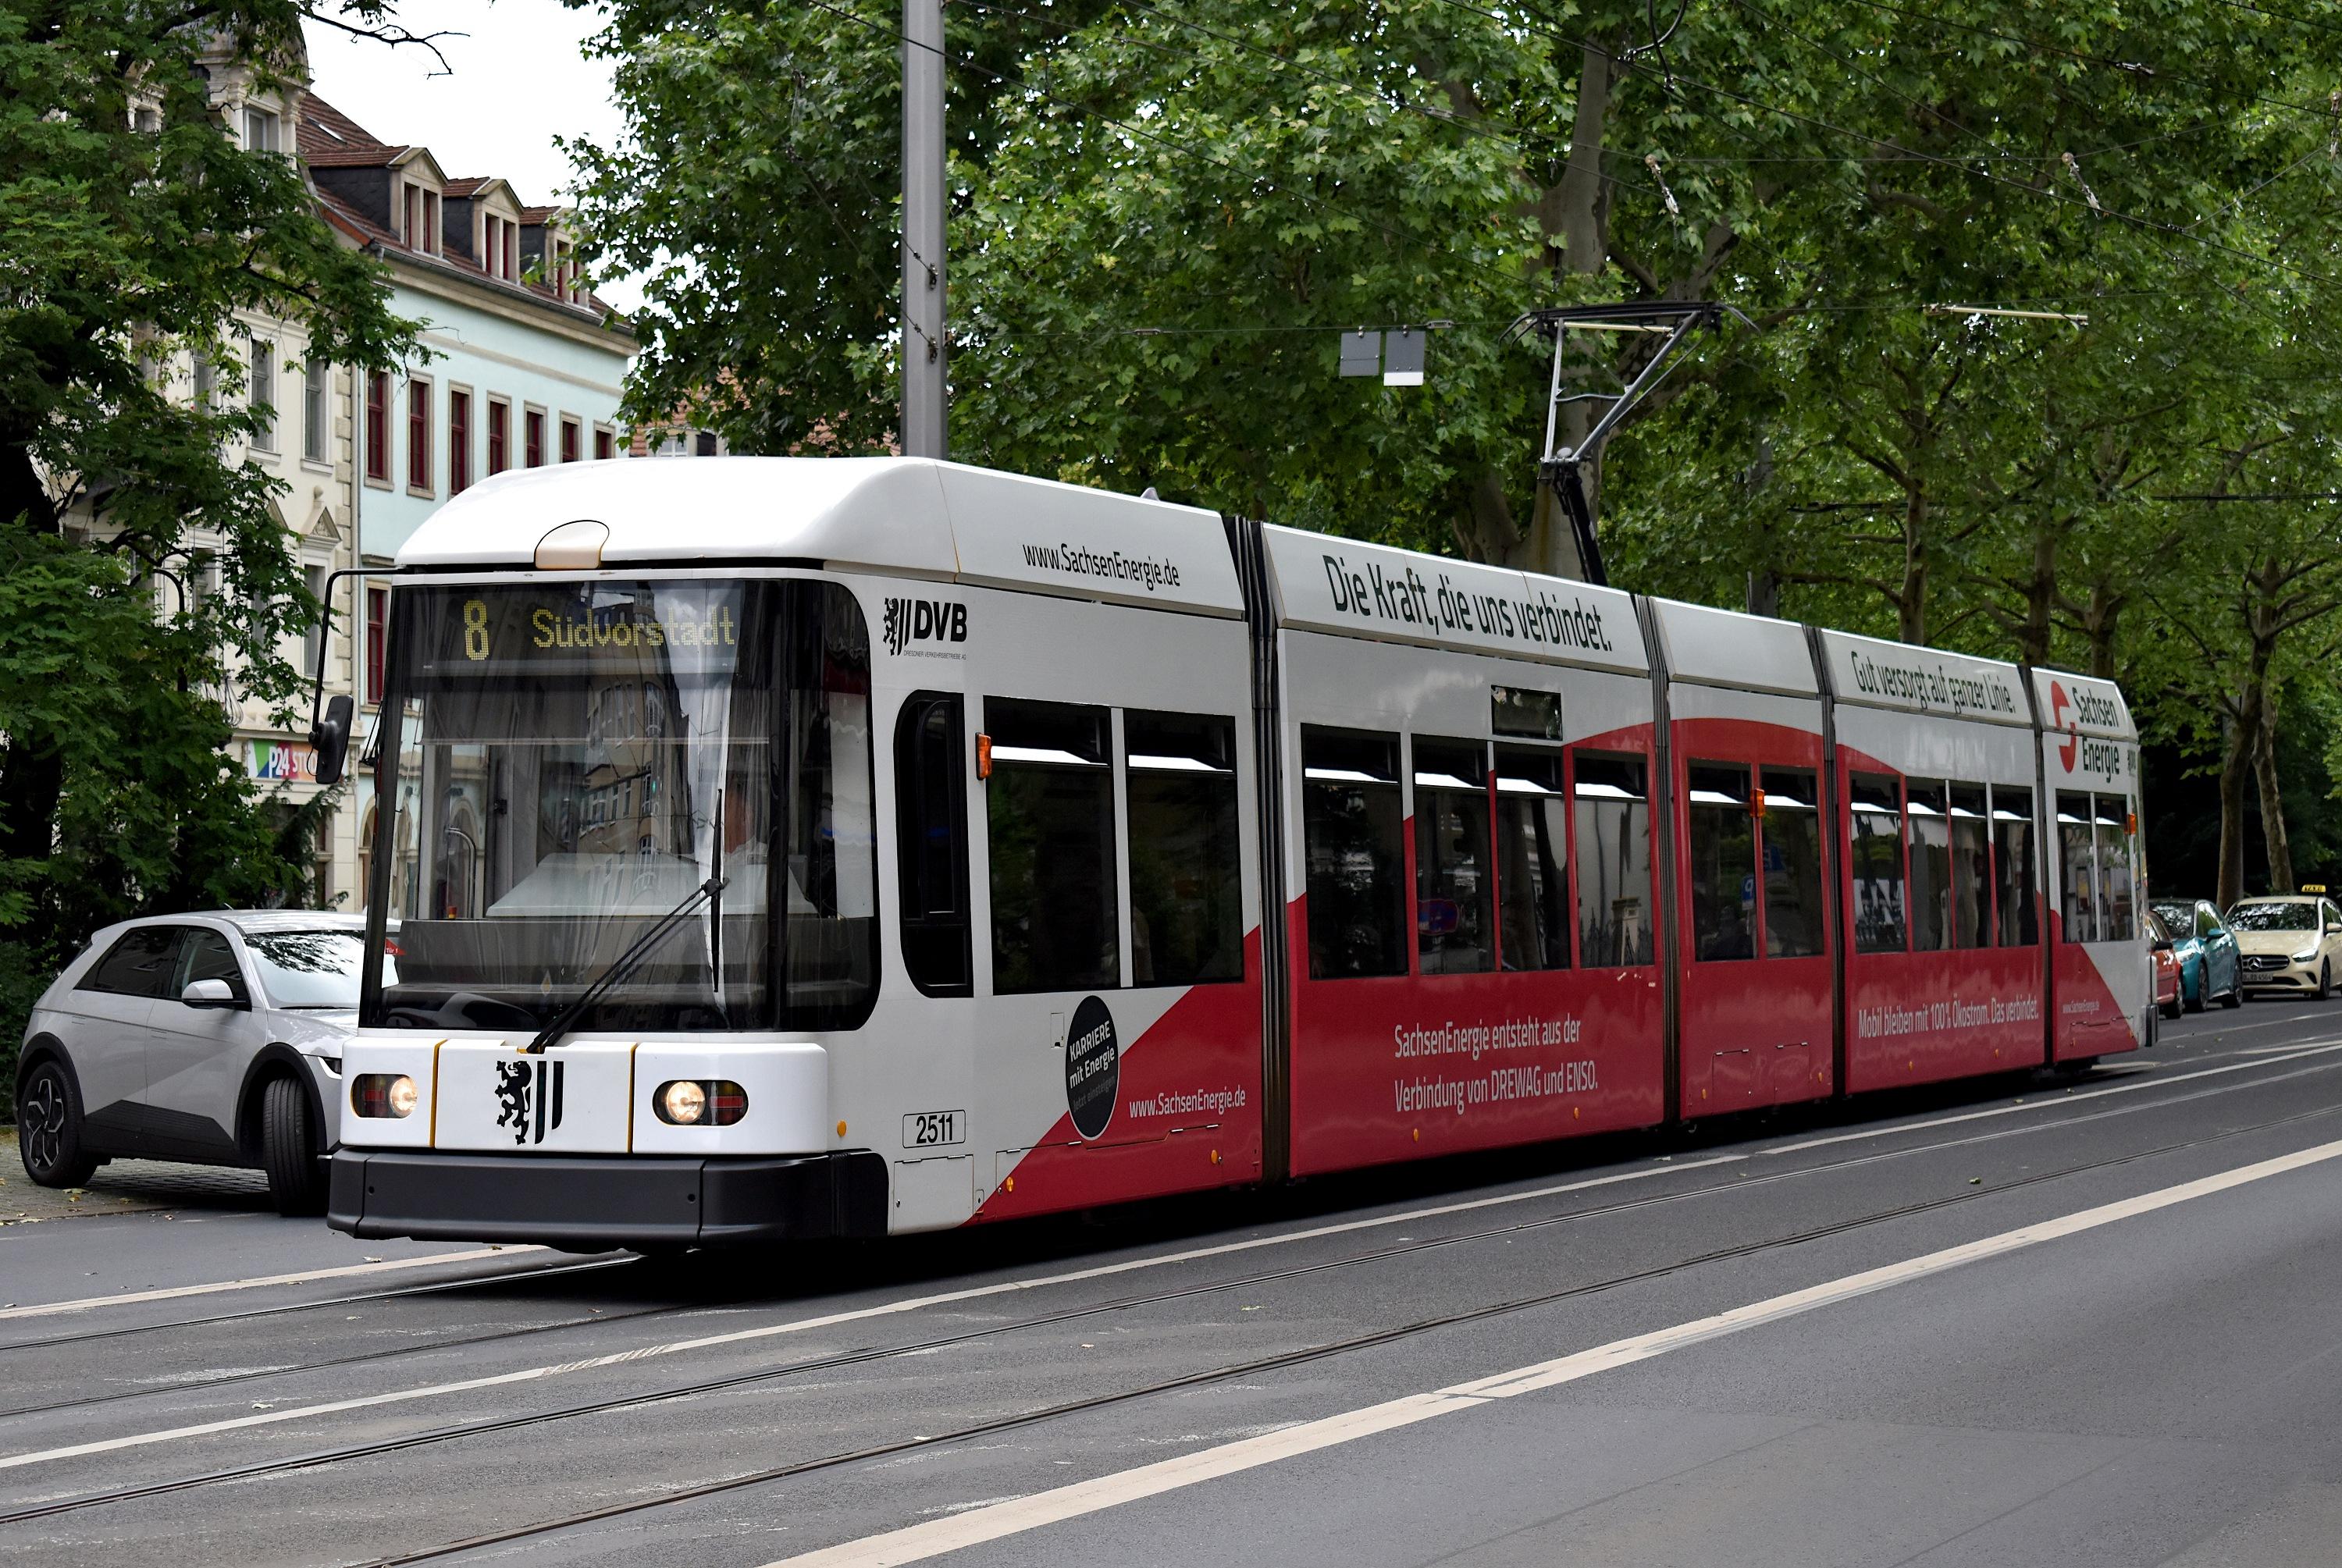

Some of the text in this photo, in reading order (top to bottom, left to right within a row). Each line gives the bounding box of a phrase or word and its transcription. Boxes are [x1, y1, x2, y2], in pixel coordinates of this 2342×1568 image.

[1022, 542, 1180, 592] www.SachsenEnergie.de
[913, 599, 967, 642] DVB
[1322, 555, 1612, 652] Die Kraft, die uns verbindet.
[463, 599, 735, 660] 8 Südvorstadt
[1851, 651, 2016, 715] Gut versorgt auf ganzer Linie.
[2072, 687, 2120, 727] Sachsen
[269, 746, 290, 778] P24
[2082, 735, 2120, 784] Energie
[1394, 1012, 1581, 1061] SachsenEnergie entsteht aus der
[1858, 1005, 1883, 1039] Mobil
[1884, 1004, 1913, 1036] bleiben
[1915, 1003, 1929, 1032] mit
[1952, 993, 1989, 1029] Ökostrom.
[1991, 997, 2004, 1025] Das
[2005, 993, 2039, 1022] verbindet.
[1070, 1020, 1111, 1062] KARRIERE
[1070, 1046, 1115, 1089] mit Energie
[1394, 1060, 1598, 1115] Verbindung von DREWAG und ENSO.
[1129, 1085, 1246, 1118] www.SachsenEnergie.de
[916, 1114, 953, 1144] 2511
